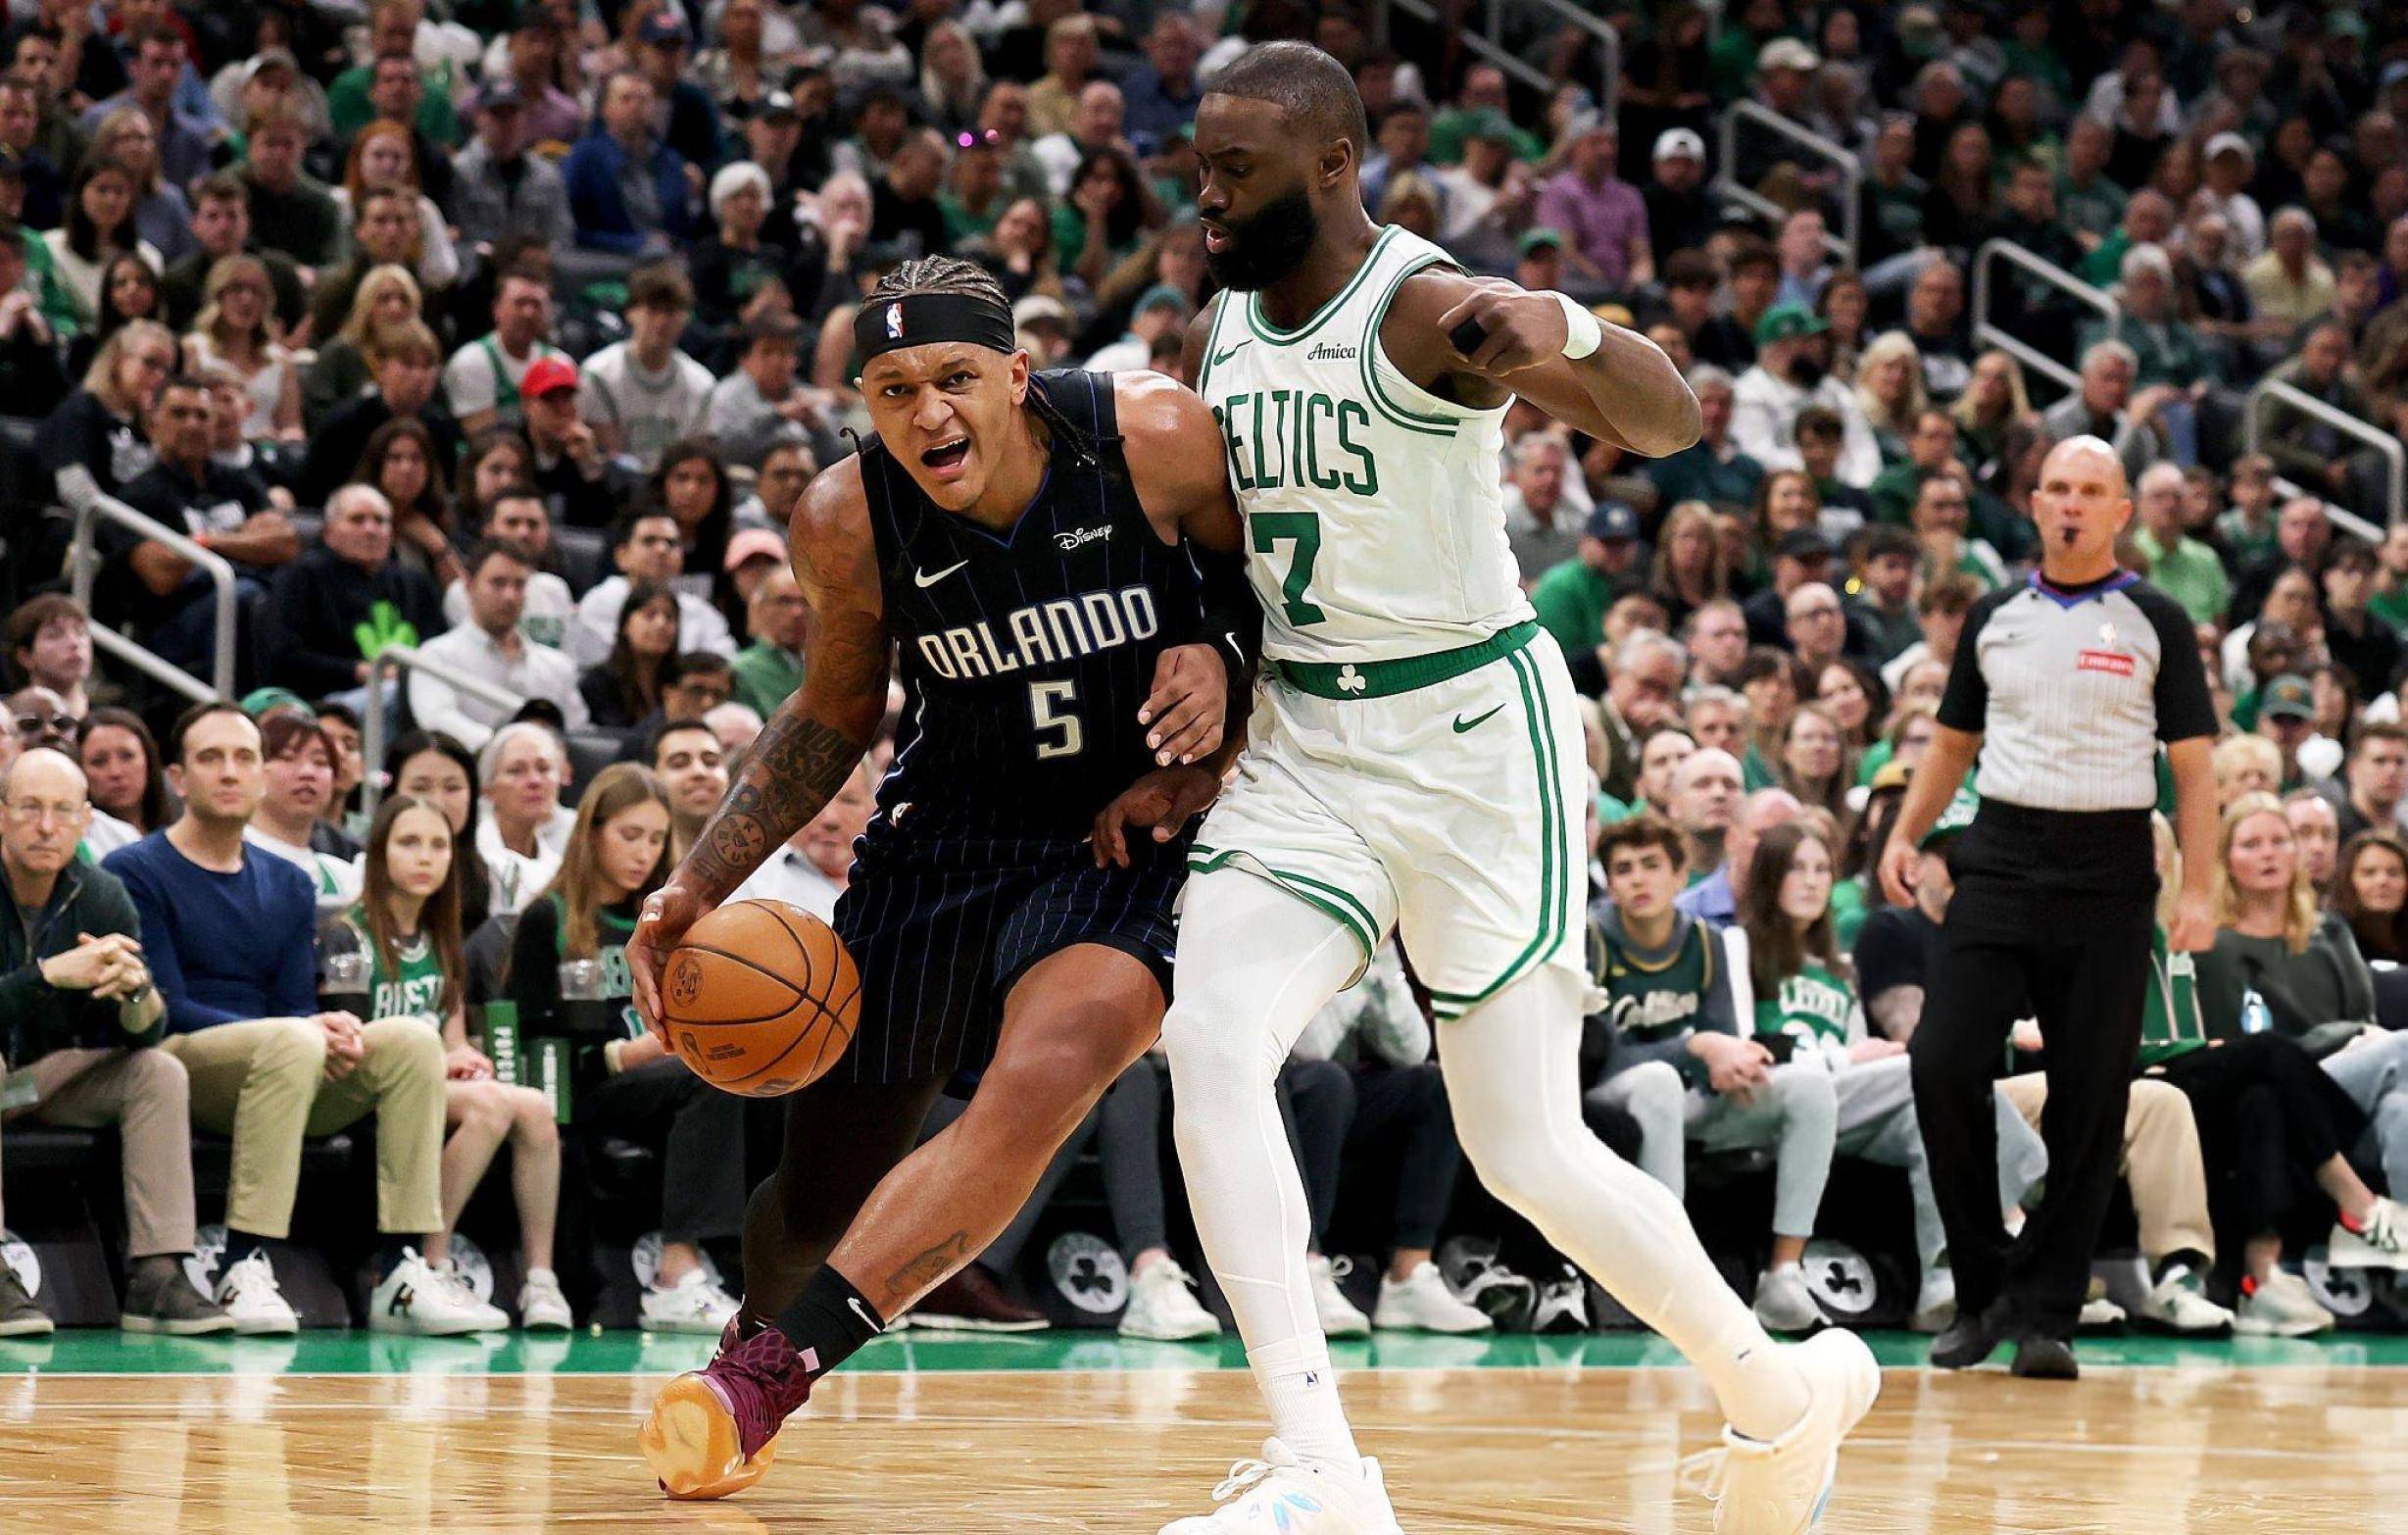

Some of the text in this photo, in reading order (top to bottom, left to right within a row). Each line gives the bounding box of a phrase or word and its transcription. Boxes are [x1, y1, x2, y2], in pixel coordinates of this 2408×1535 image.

[1307, 341, 1356, 361] Amica
[1212, 390, 1379, 496] ELTICS
[1053, 524, 1113, 550] Disney
[1249, 512, 1327, 627] 7
[917, 585, 1159, 679] ORLANDO
[1029, 679, 1085, 760] 5
